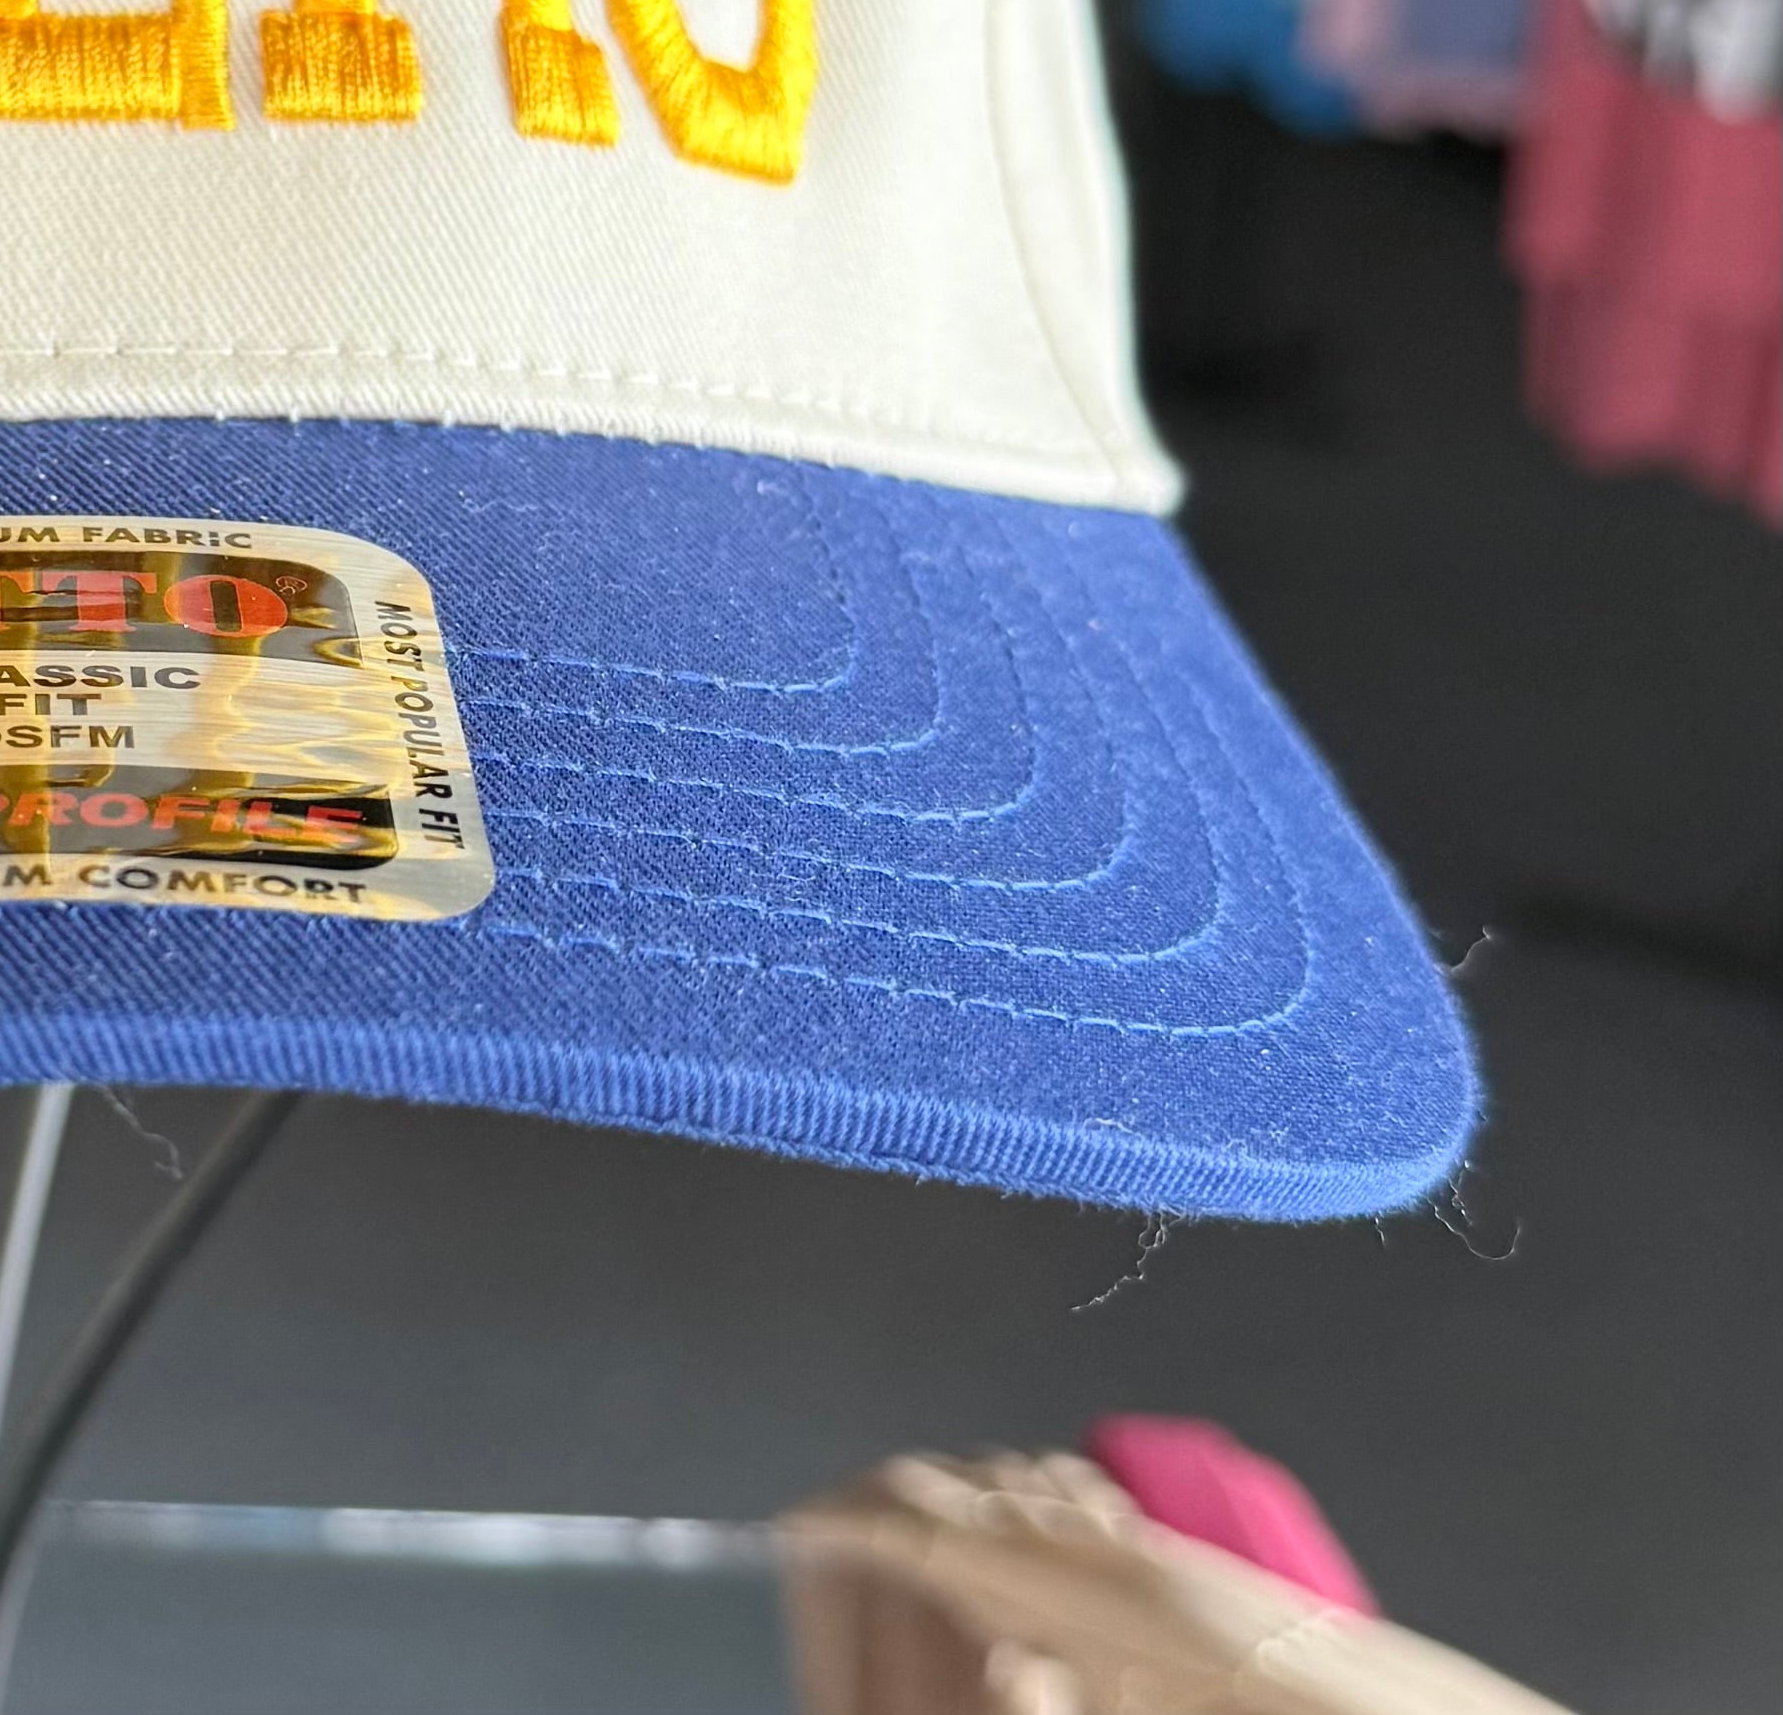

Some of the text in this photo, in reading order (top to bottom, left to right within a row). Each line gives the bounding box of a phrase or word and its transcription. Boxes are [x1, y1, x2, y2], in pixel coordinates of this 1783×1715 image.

[83, 526, 252, 549] FABRIC
[374, 601, 465, 850] MOST POPULAR FIT
[78, 865, 367, 905] COMFORT
